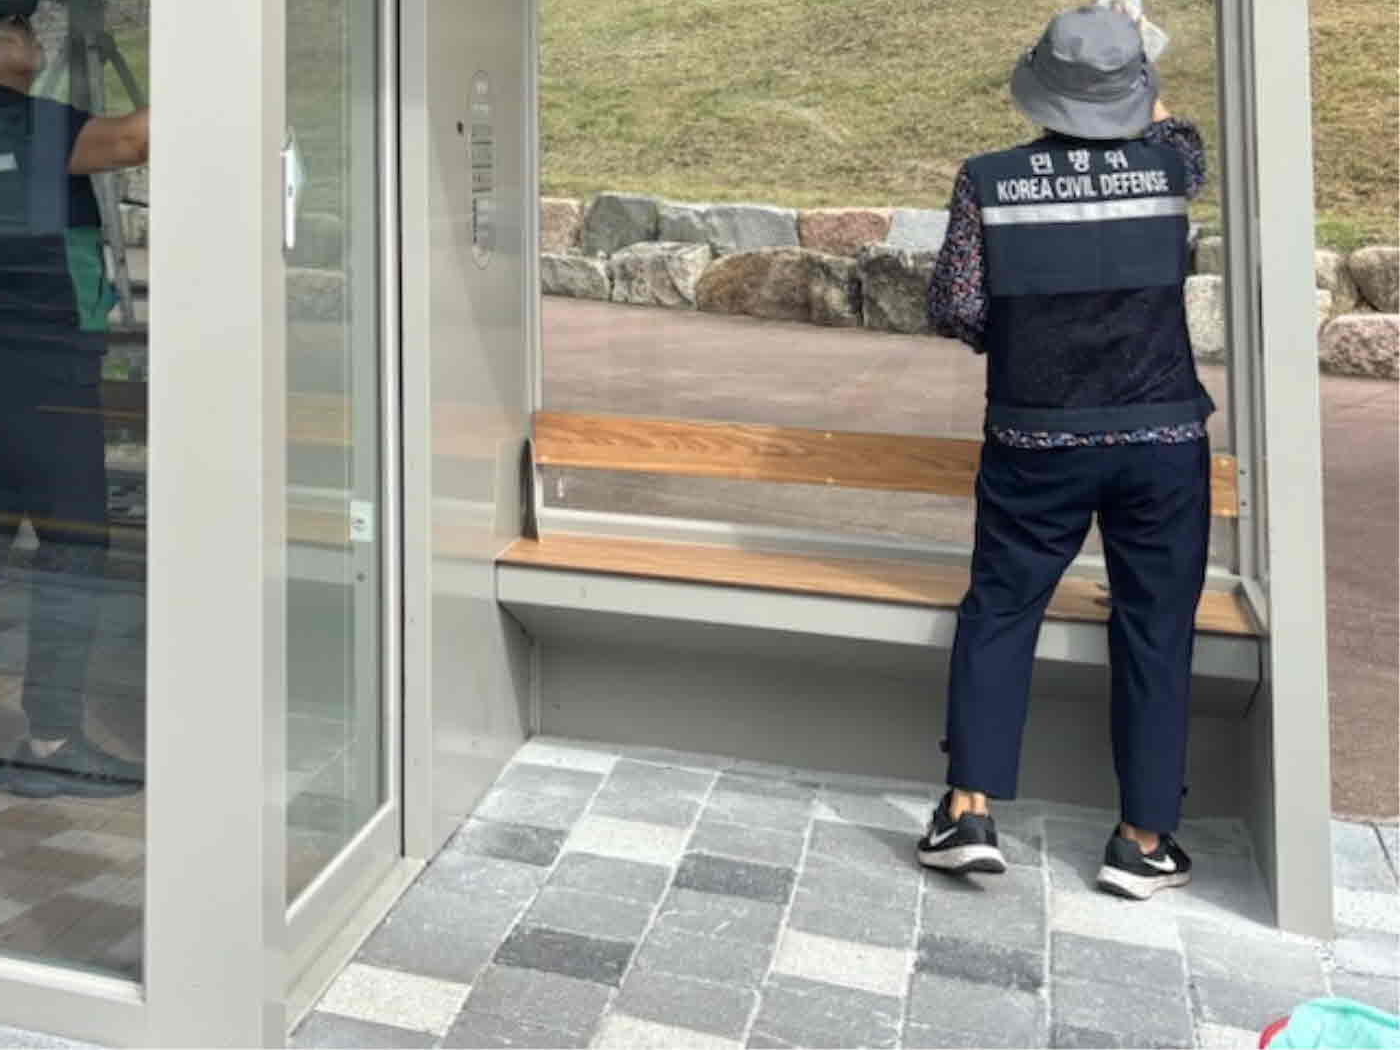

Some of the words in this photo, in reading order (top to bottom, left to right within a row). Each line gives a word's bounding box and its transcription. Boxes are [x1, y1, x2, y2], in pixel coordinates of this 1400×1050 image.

[997, 177, 1054, 201] KOREA
[1055, 174, 1099, 198] CIVIL
[1099, 170, 1170, 196] DEFENSE
